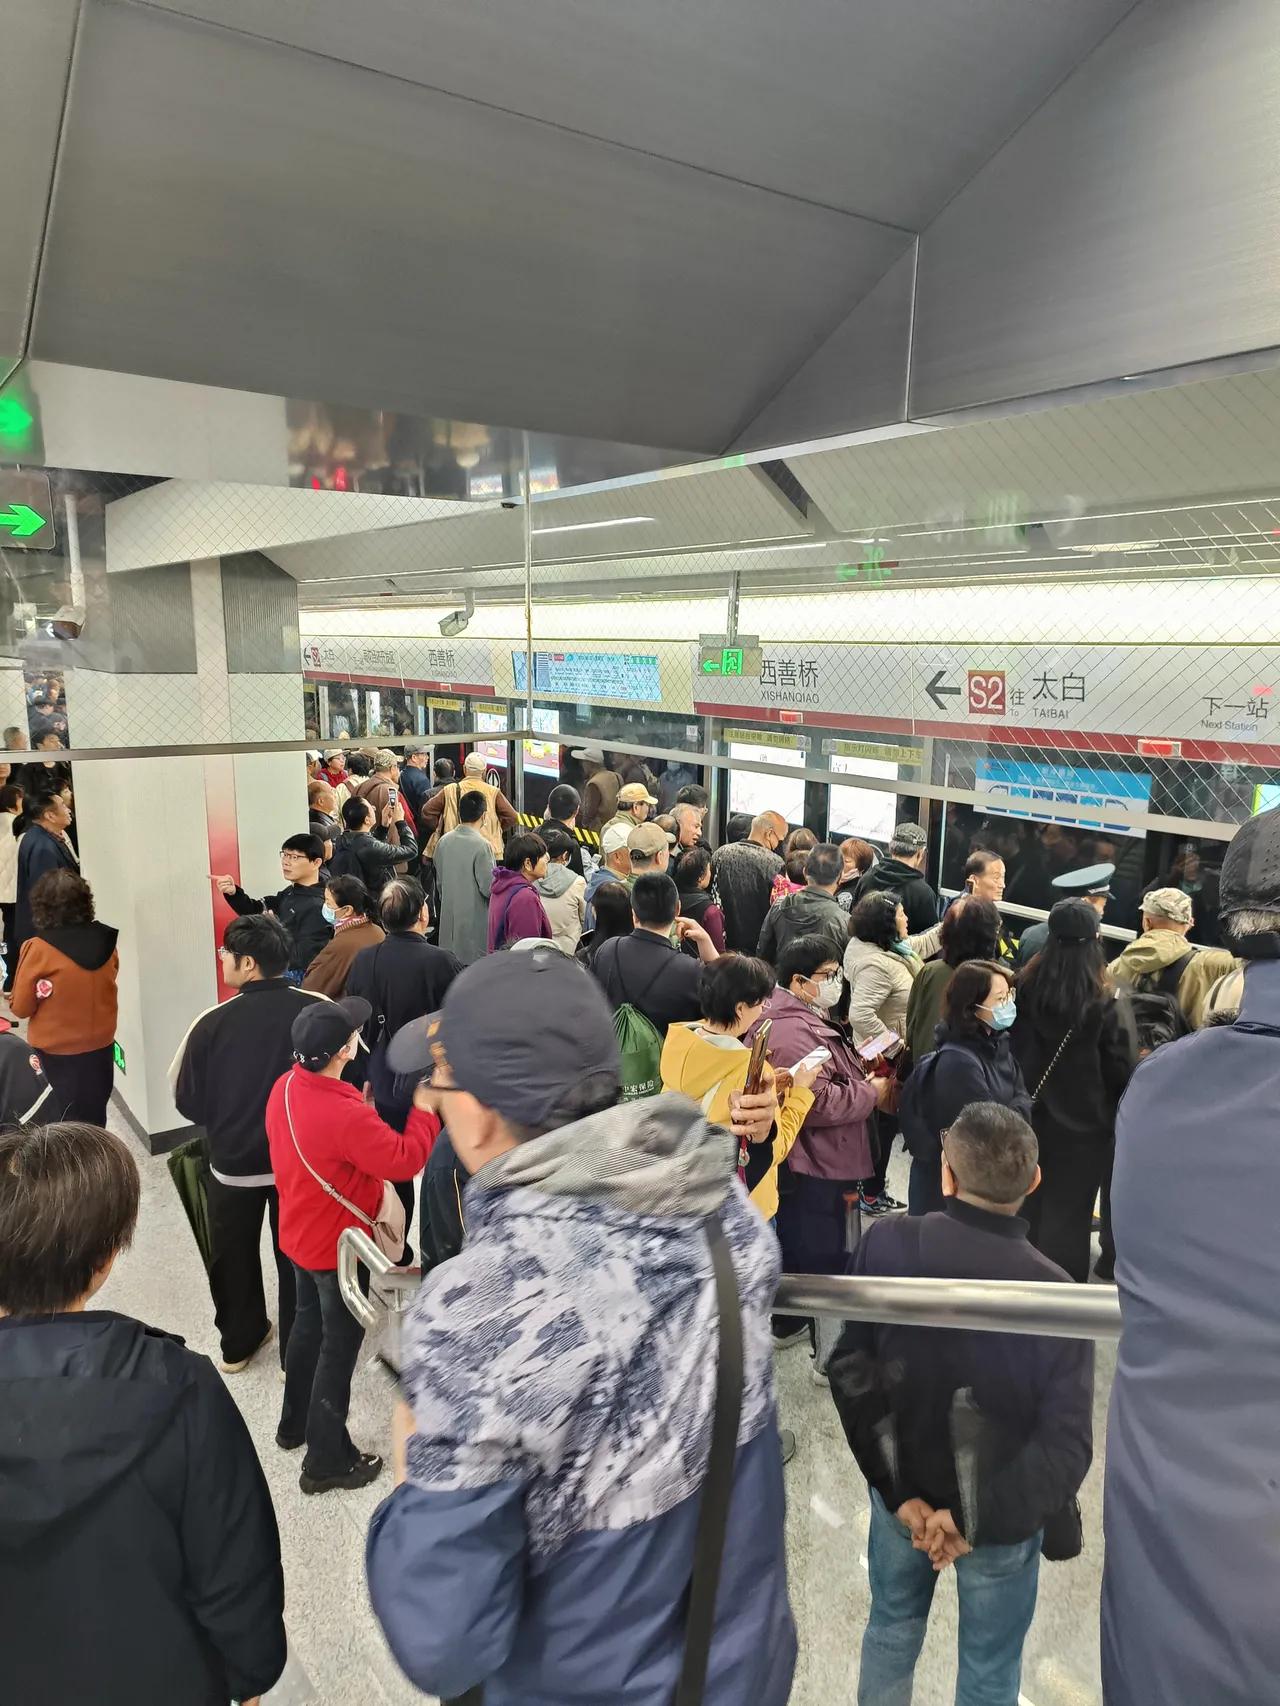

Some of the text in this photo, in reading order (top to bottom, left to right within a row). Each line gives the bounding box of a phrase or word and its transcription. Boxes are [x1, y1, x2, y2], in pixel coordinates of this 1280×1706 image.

[760, 659, 818, 688] 西善桥
[761, 690, 820, 704] XISHANQIAO
[970, 671, 1085, 709] S2 往 太白
[1033, 708, 1069, 719] TAIBAI
[1202, 697, 1269, 719] 下一站
[1200, 719, 1258, 732] Next Station
